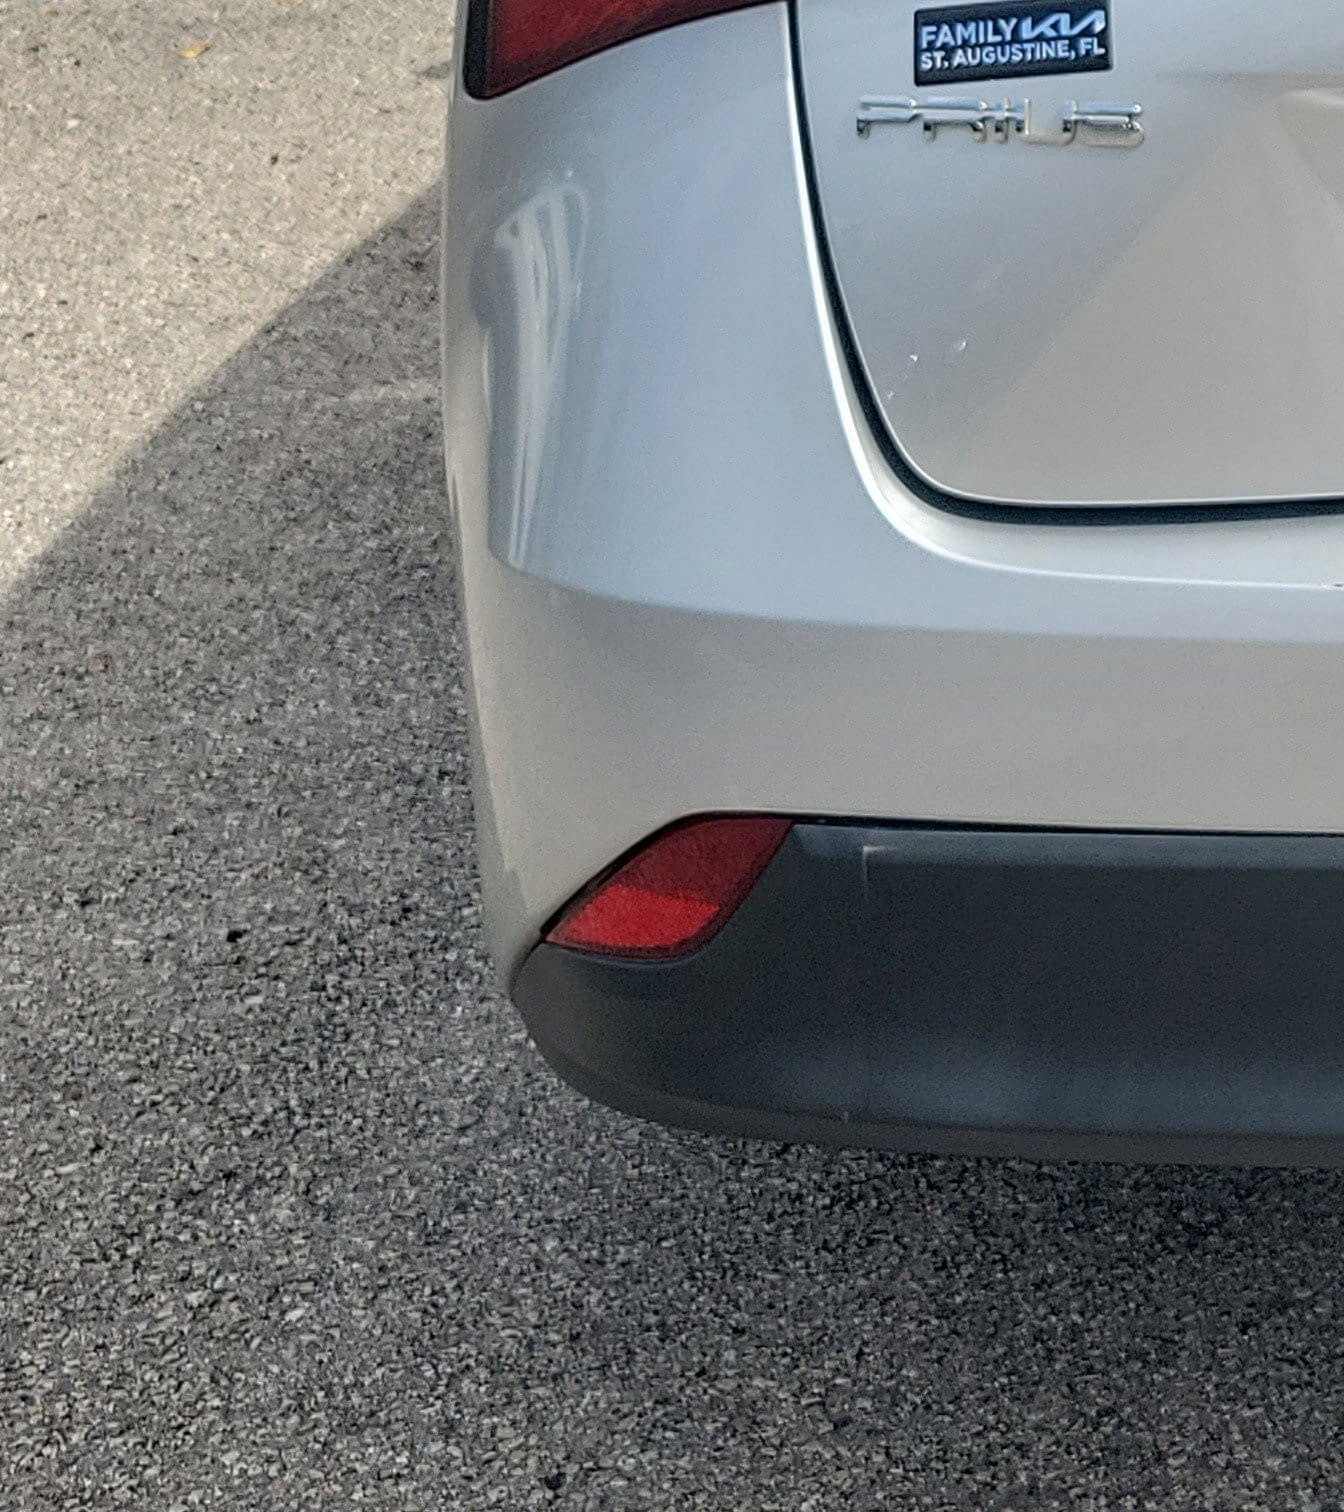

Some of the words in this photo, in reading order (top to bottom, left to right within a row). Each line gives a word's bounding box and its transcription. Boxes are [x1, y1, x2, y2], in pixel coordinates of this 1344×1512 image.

[920, 16, 1018, 50] FAMILY
[1021, 9, 1106, 39] KIA
[919, 50, 949, 72] ST.
[953, 38, 1076, 69] AUGUSTINE,
[1079, 37, 1106, 57] FL
[856, 95, 1145, 147] PRIUS
